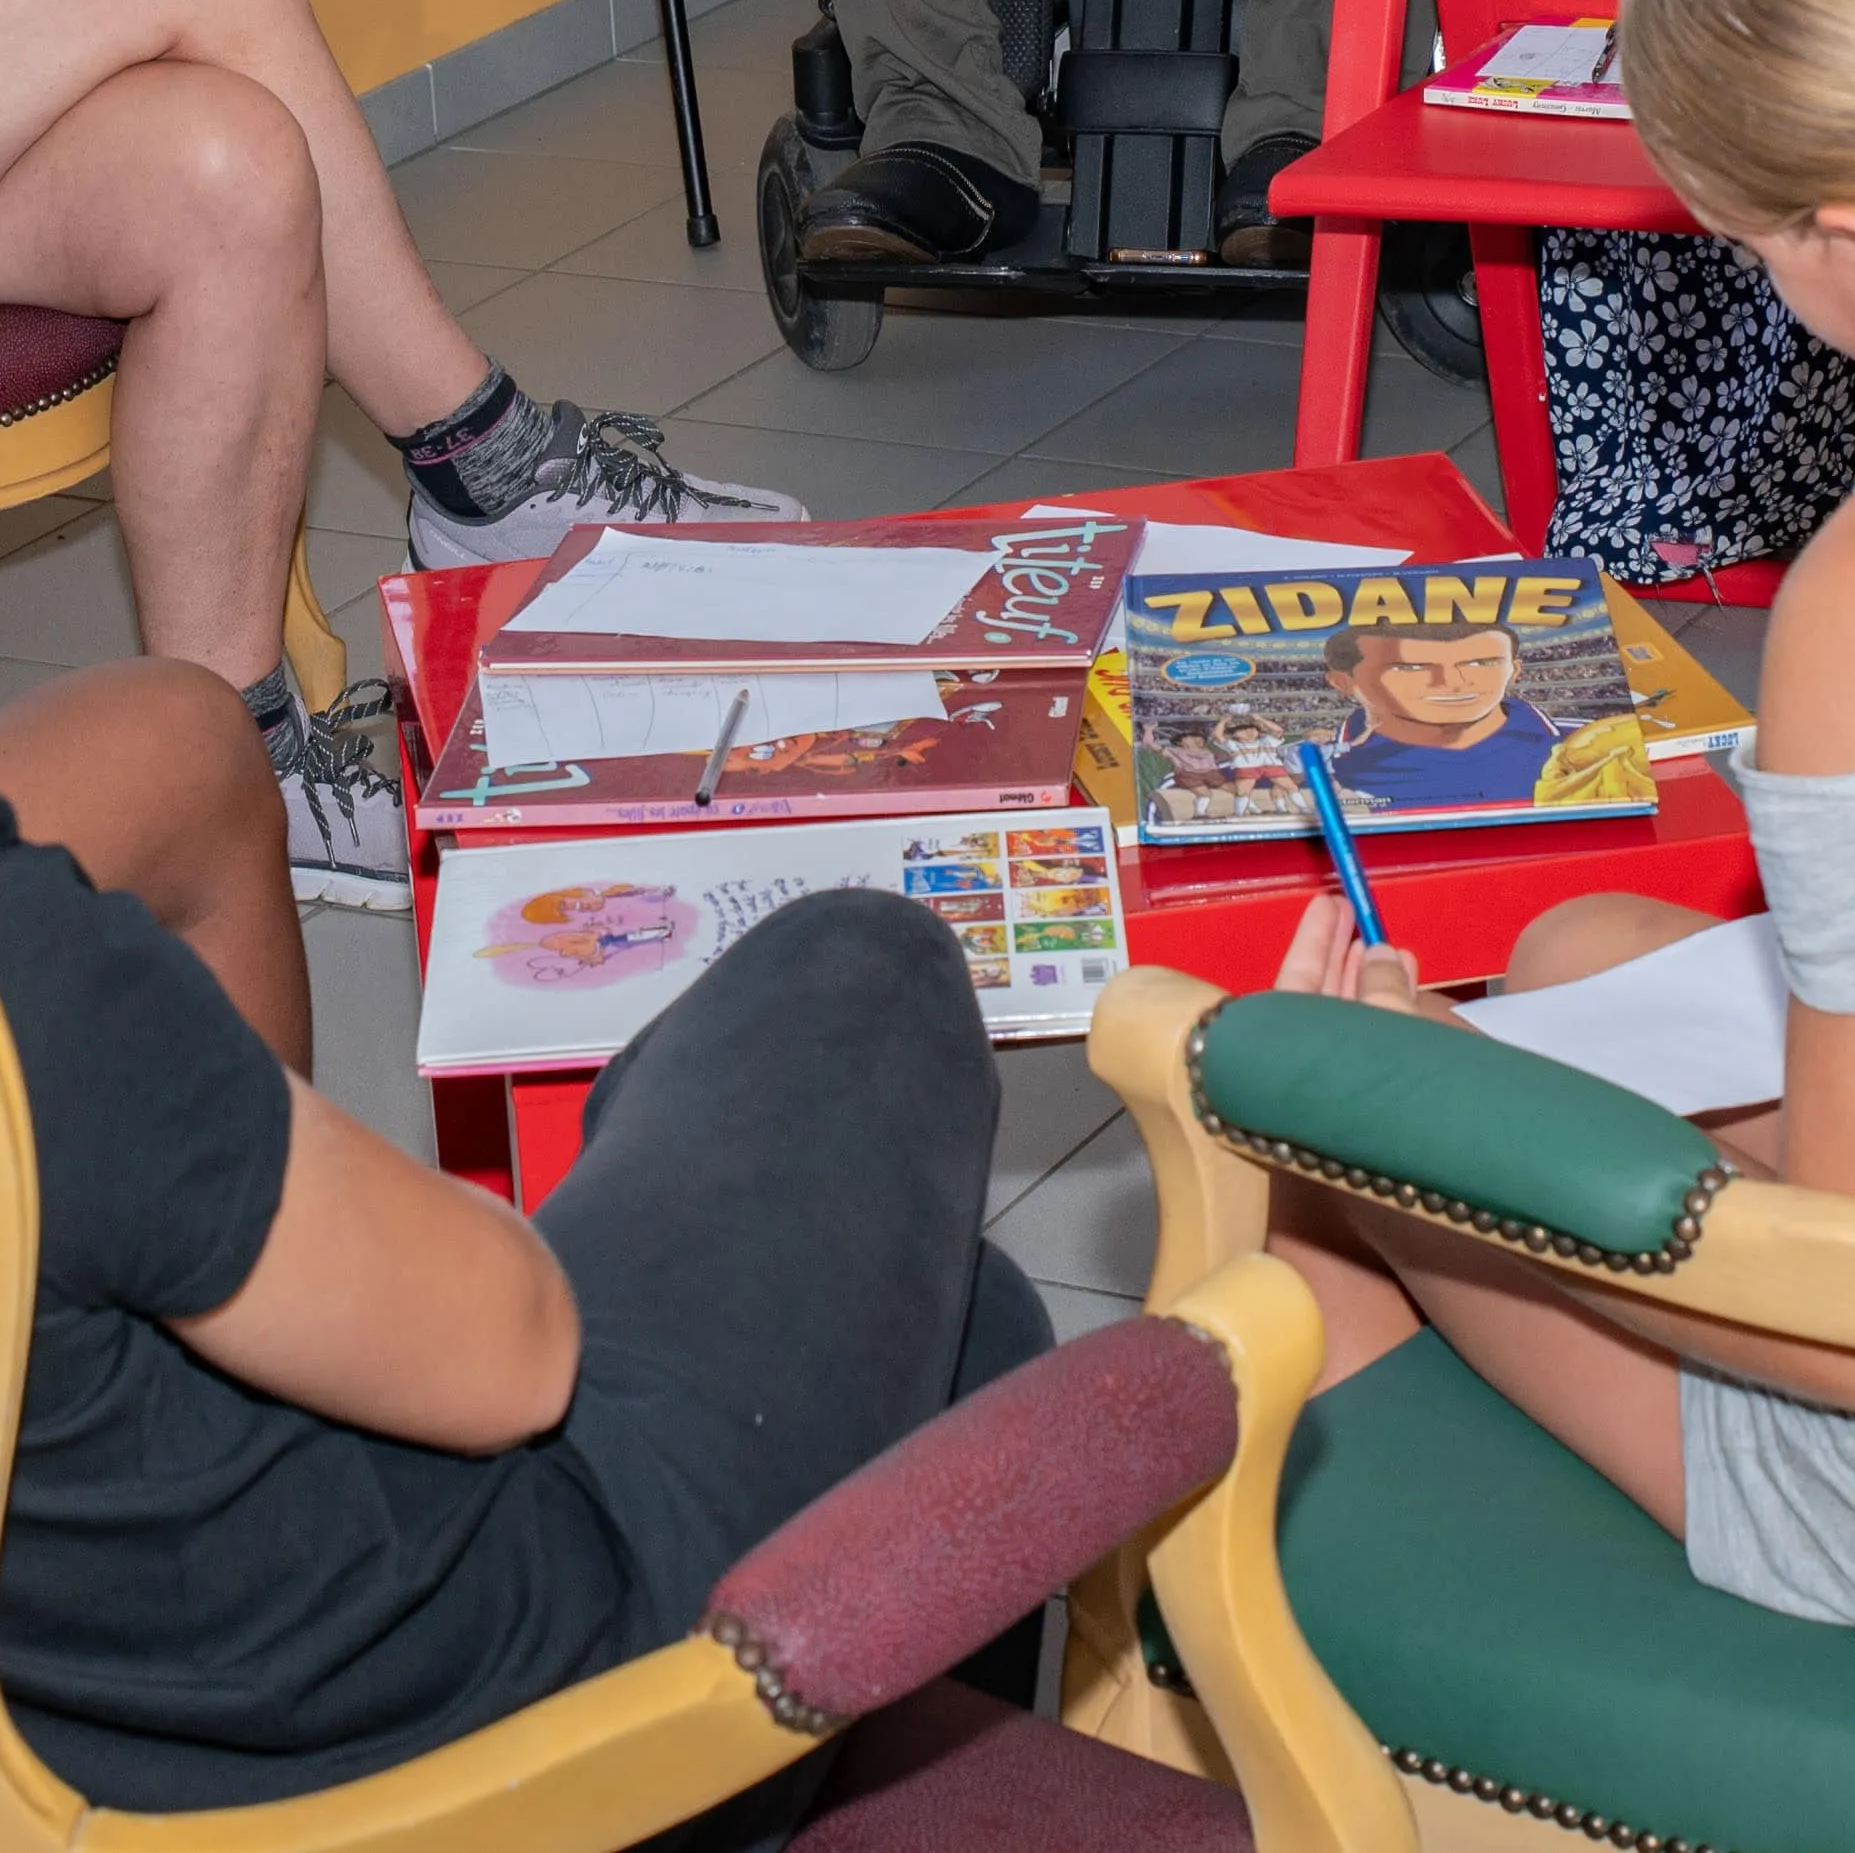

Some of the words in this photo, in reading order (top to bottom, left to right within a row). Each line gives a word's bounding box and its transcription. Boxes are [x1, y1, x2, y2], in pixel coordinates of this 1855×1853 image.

[1143, 576, 1584, 644] ZIDANE
[999, 792, 1035, 805] Glénat
[434, 810, 464, 825] ZEP
